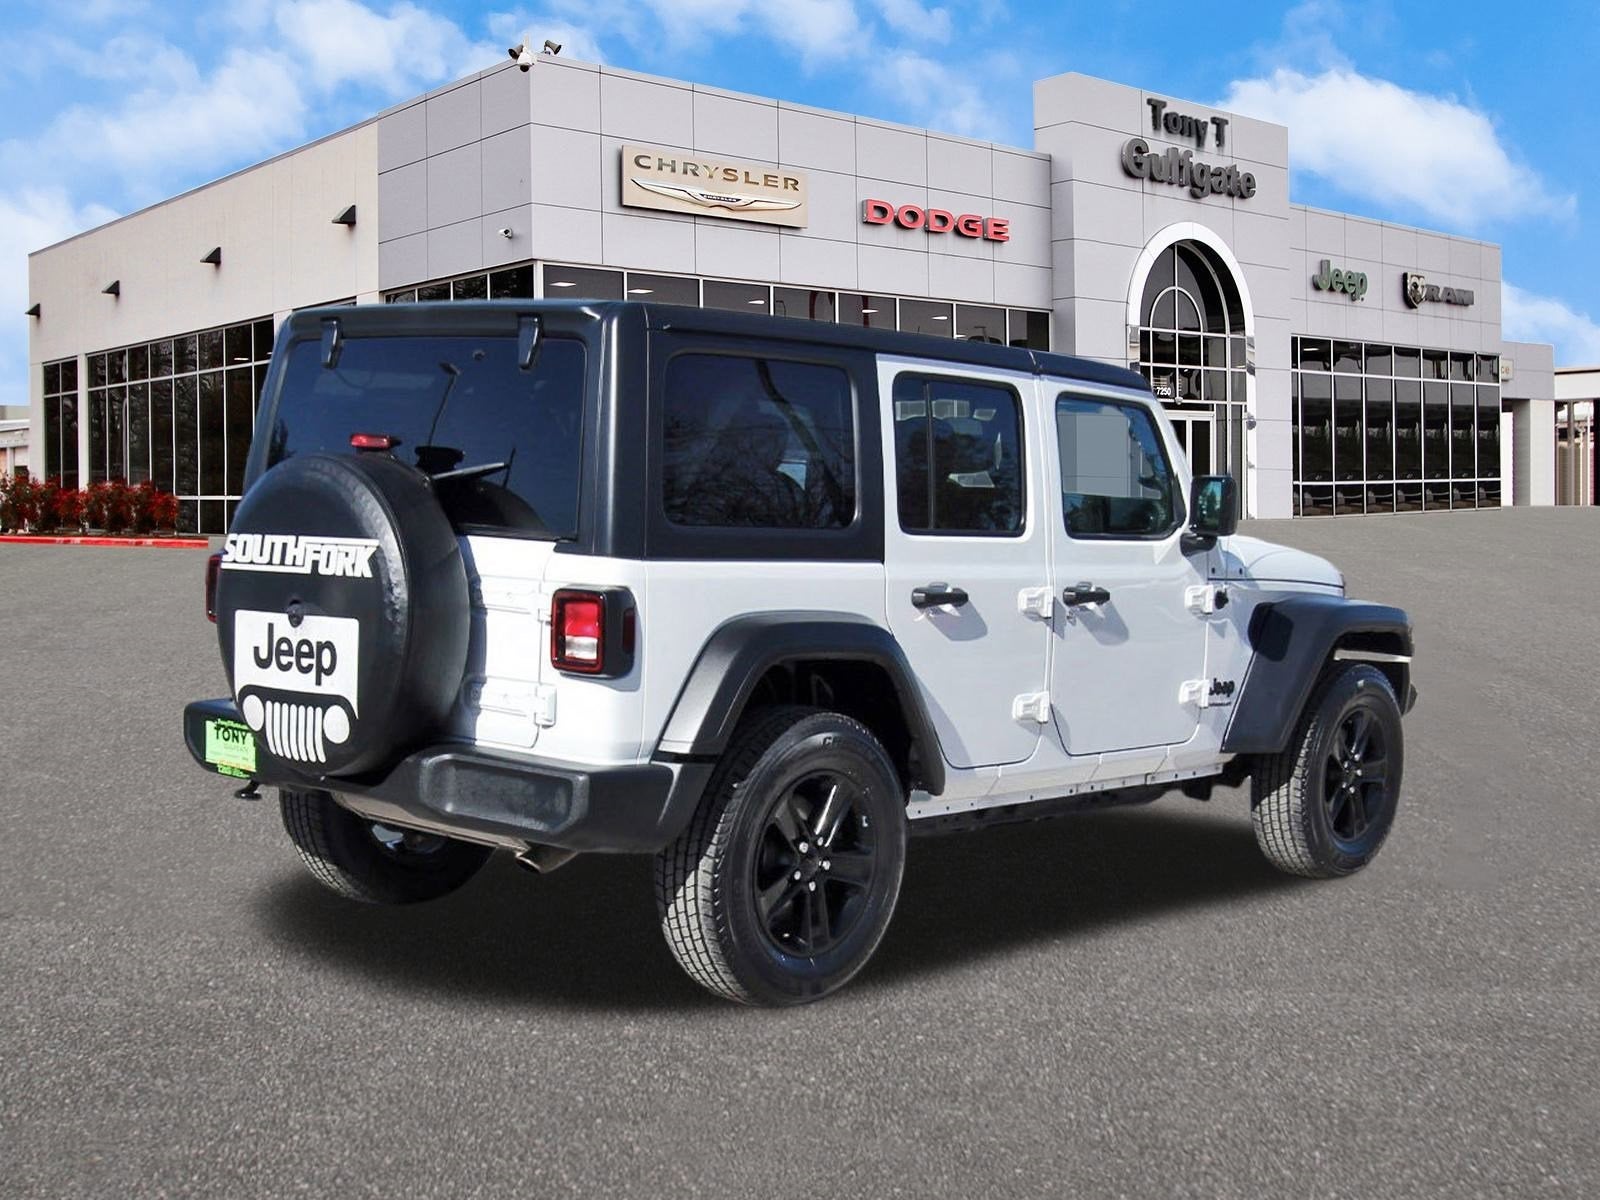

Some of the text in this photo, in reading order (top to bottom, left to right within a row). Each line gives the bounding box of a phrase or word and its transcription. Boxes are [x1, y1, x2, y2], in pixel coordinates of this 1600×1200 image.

[1146, 97, 1229, 148] Tony T
[633, 154, 800, 191] CHRYSLER
[1121, 137, 1257, 199] Gulfgate
[863, 198, 1010, 242] DODGE
[1312, 259, 1368, 302] Jeep
[1425, 283, 1475, 306] RAM
[221, 533, 380, 578] SOUTHFORK
[253, 622, 338, 687] Jeep
[1208, 677, 1235, 698] Jeep
[214, 724, 248, 745] TONY
